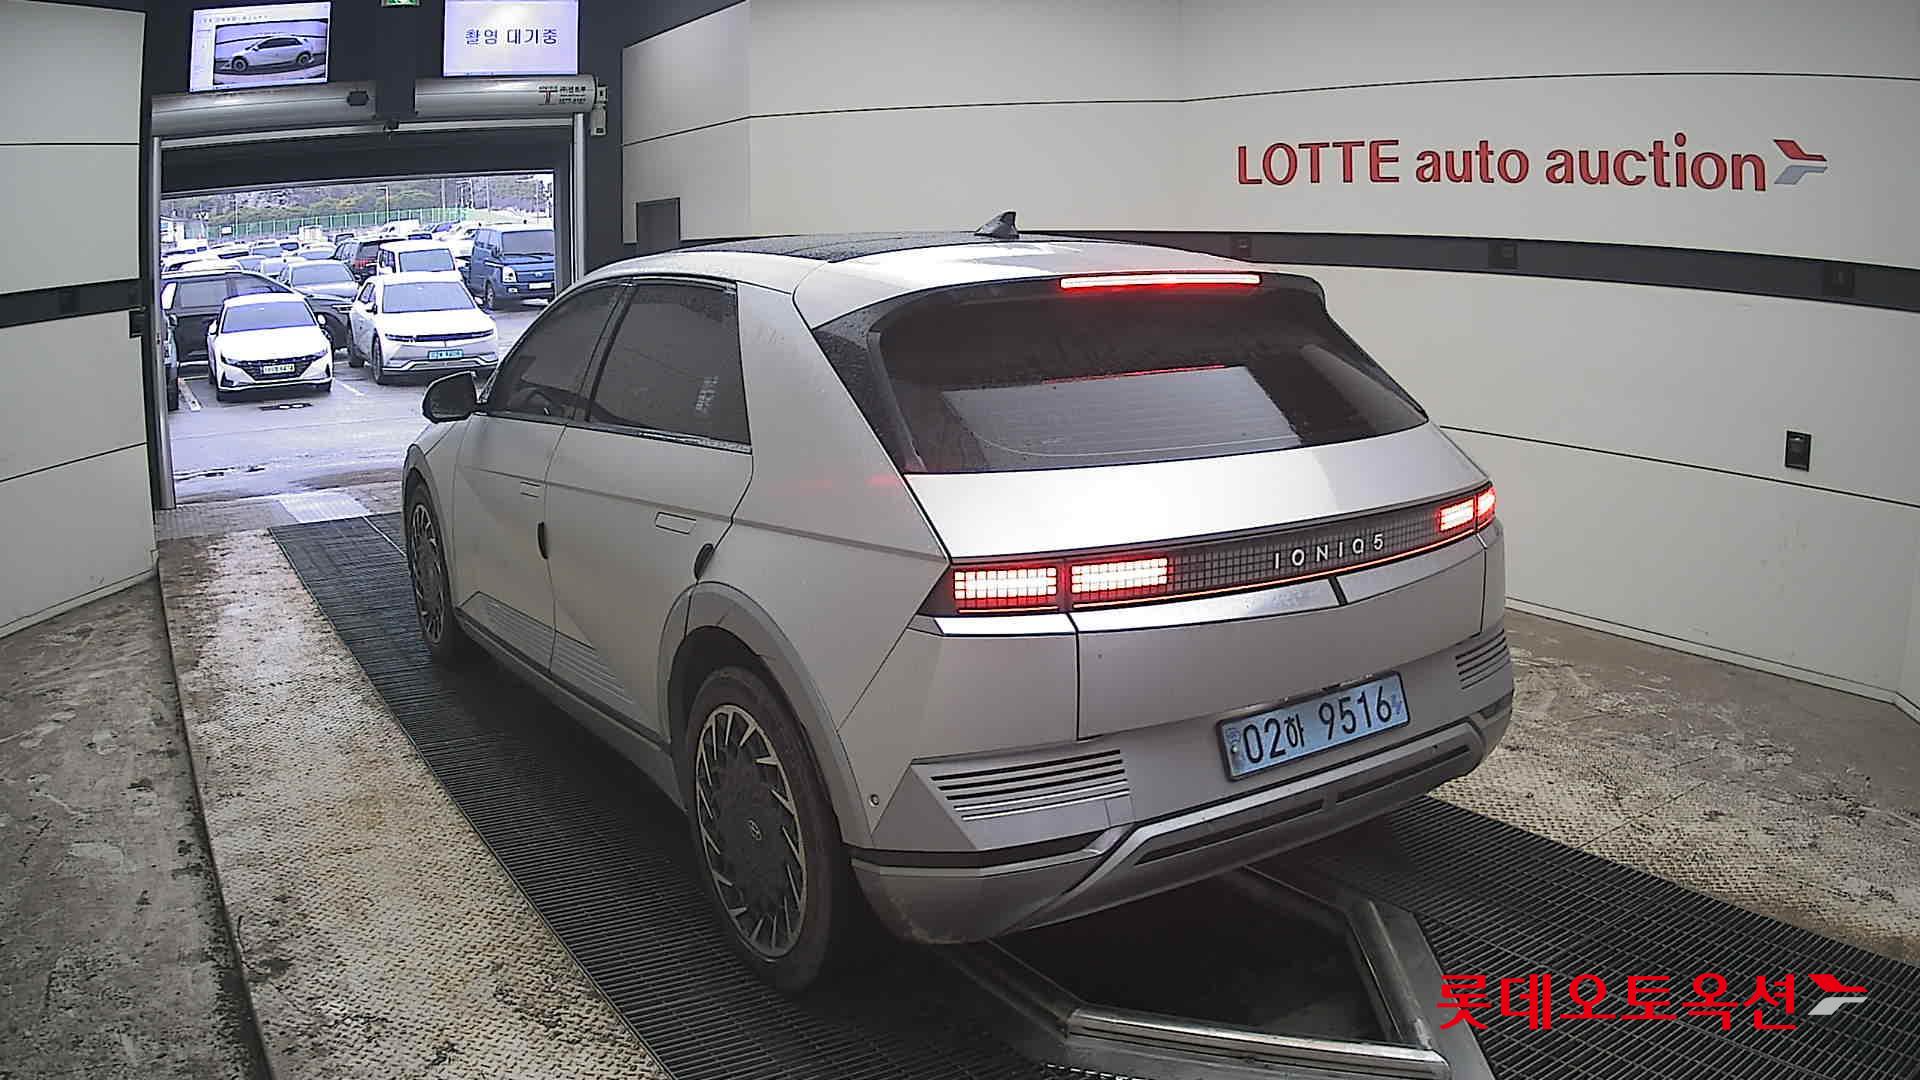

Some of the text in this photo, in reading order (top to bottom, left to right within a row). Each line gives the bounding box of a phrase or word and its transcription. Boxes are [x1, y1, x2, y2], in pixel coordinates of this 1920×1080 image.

[465, 28, 558, 45] 촬영 대기중
[1237, 132, 1766, 191] LOTTE auto auction
[1242, 685, 1393, 764] 02하 9516
